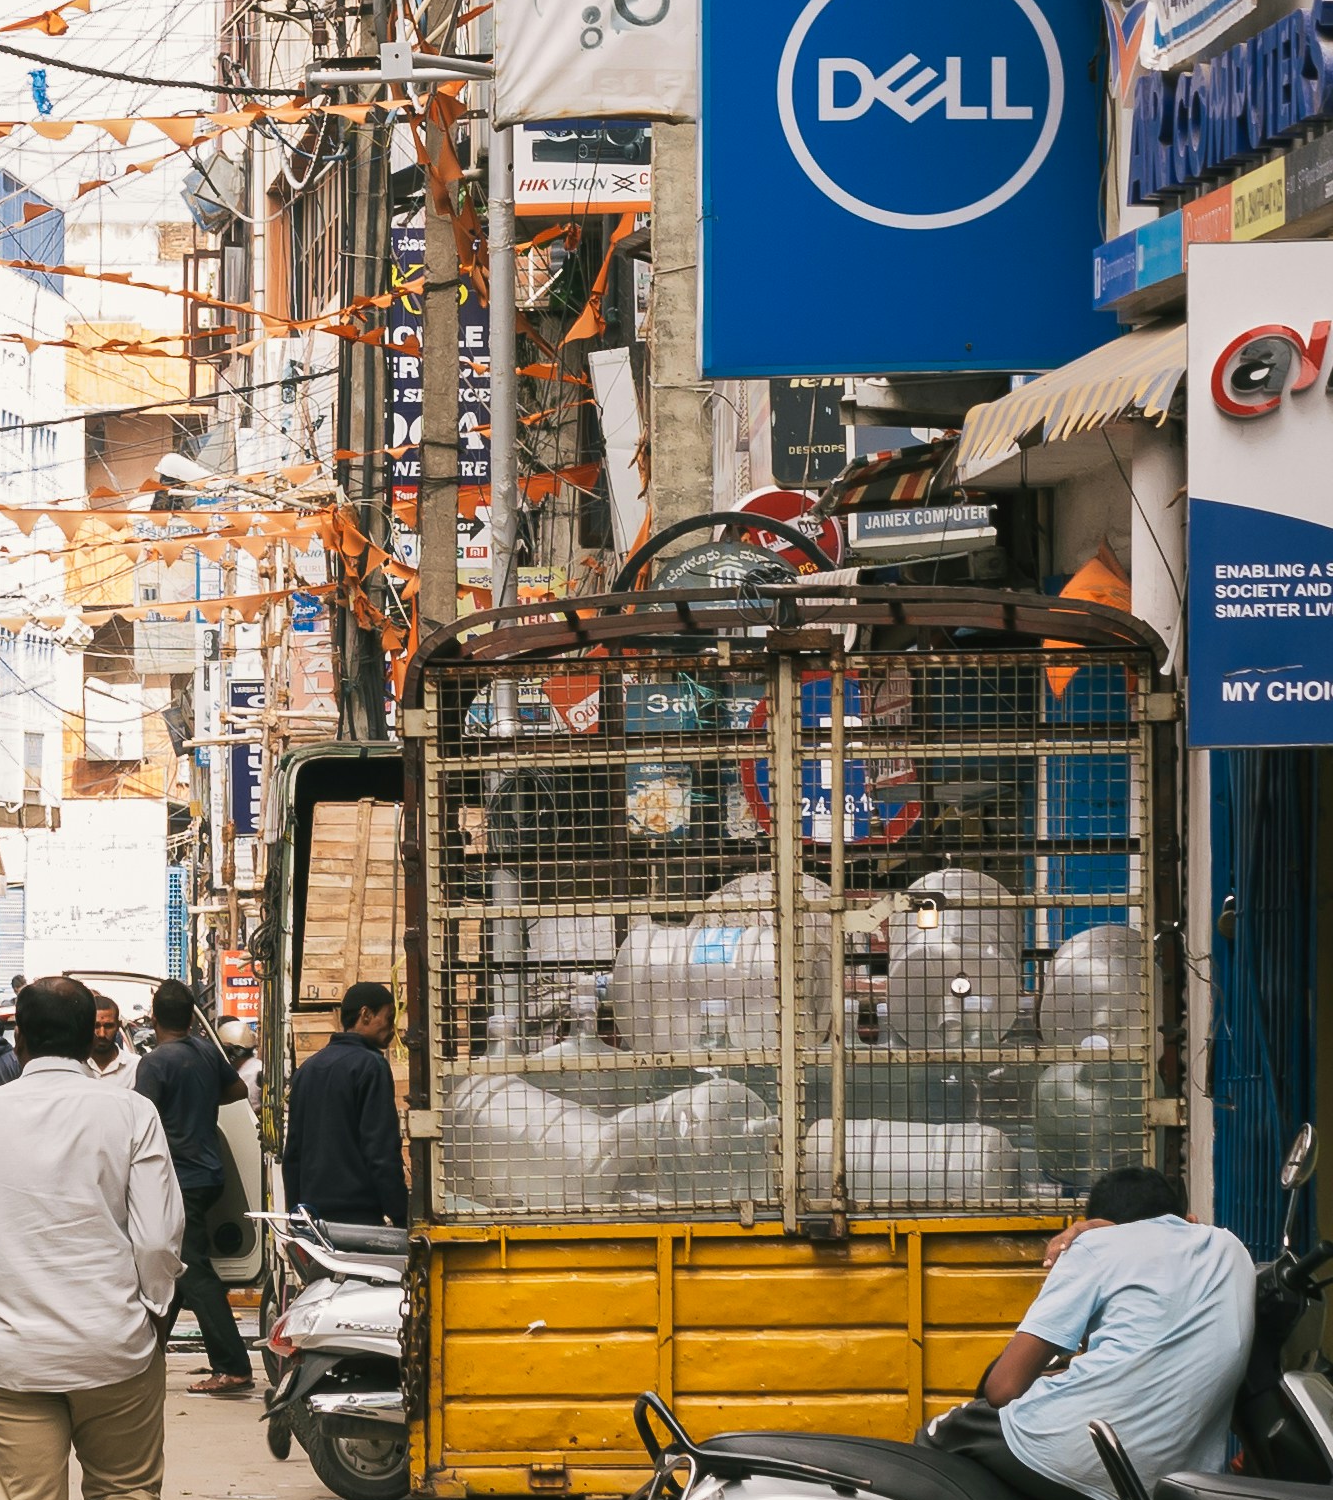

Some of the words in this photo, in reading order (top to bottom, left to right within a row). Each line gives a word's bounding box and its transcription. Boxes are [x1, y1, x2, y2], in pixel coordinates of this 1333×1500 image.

[818, 52, 1033, 123] DELL
[519, 176, 609, 193] HIKVISION
[788, 445, 845, 455] DESKTOPS
[864, 510, 911, 529] JAINEX
[915, 505, 988, 528] COMPUTER
[1215, 564, 1305, 579] ENABLING
[1309, 564, 1322, 577] A
[1215, 584, 1289, 598] SOCIETY
[1215, 604, 1300, 618] SMARTER
[1222, 682, 1259, 703] MY
